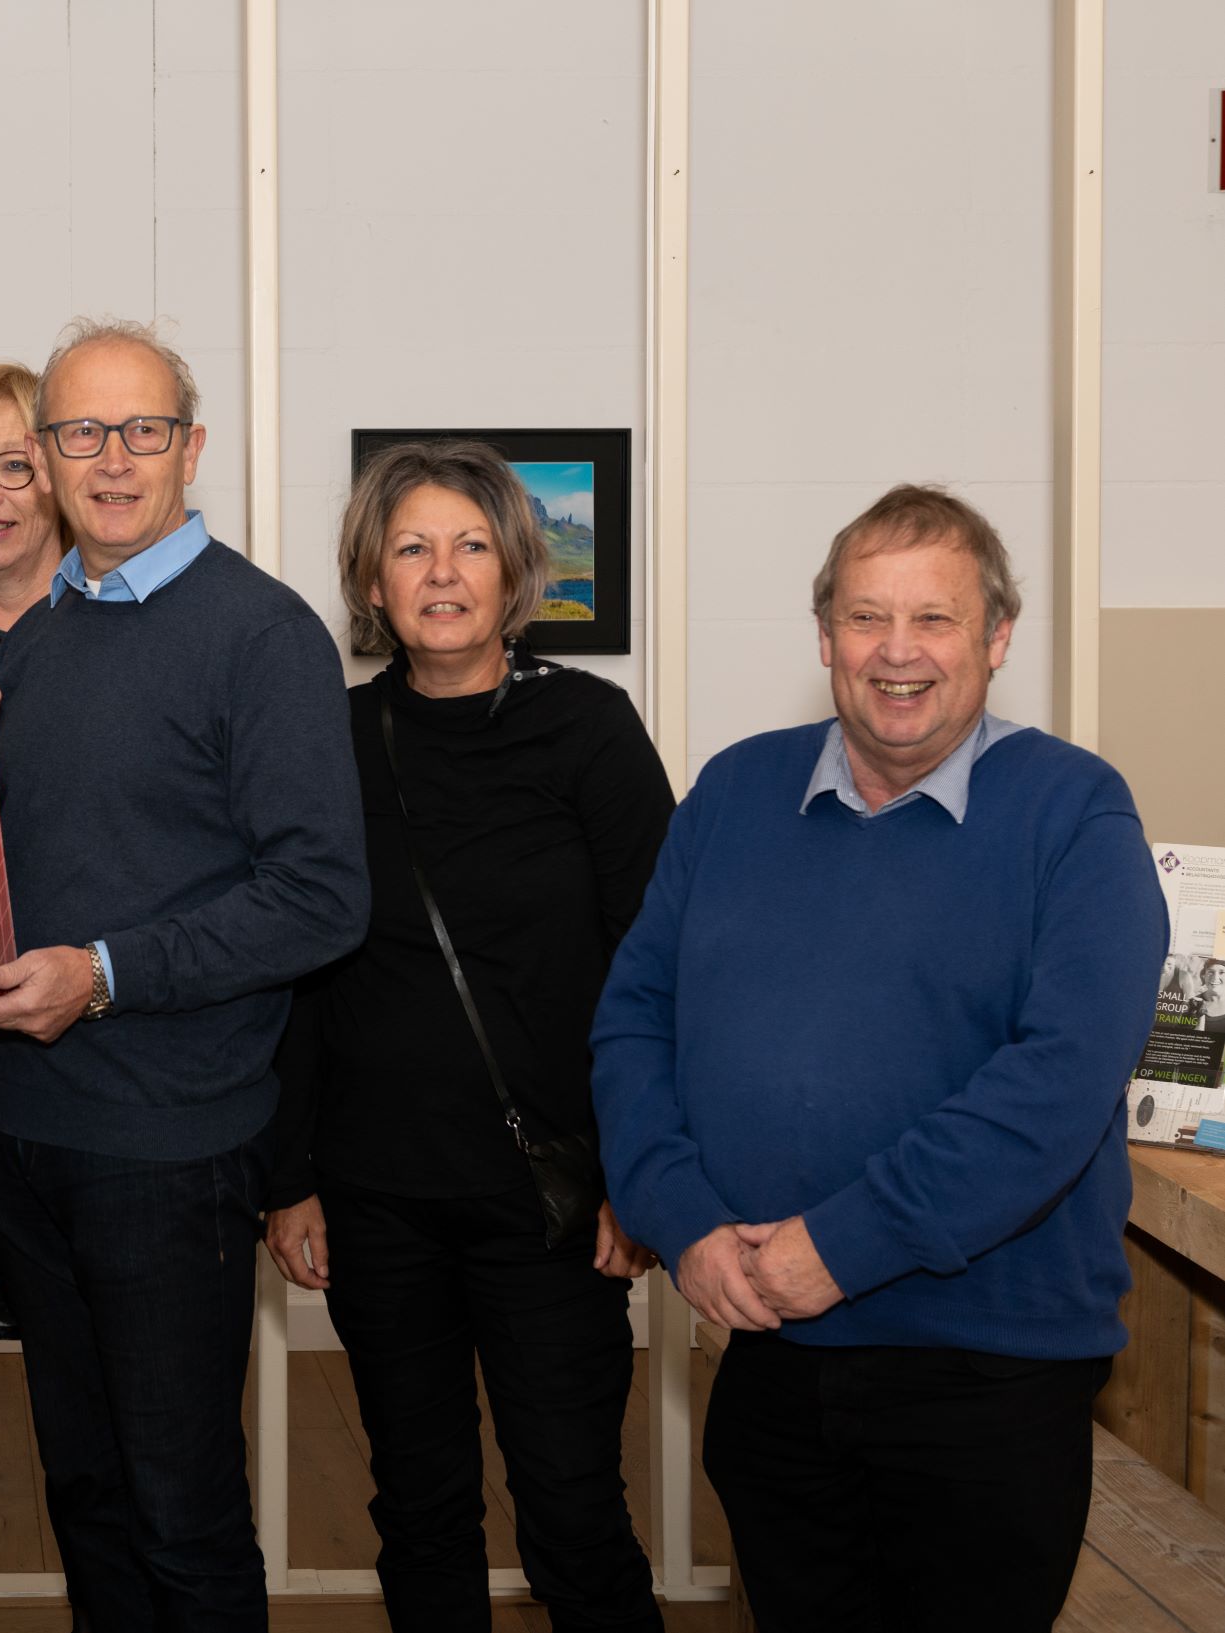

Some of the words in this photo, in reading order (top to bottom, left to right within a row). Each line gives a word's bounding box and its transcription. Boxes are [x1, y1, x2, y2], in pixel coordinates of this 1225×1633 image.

[1157, 991, 1188, 1002] SMALL
[1155, 1002, 1189, 1013] GROUP
[1155, 1013, 1199, 1026] TRAINING
[1140, 1068, 1153, 1077] OP
